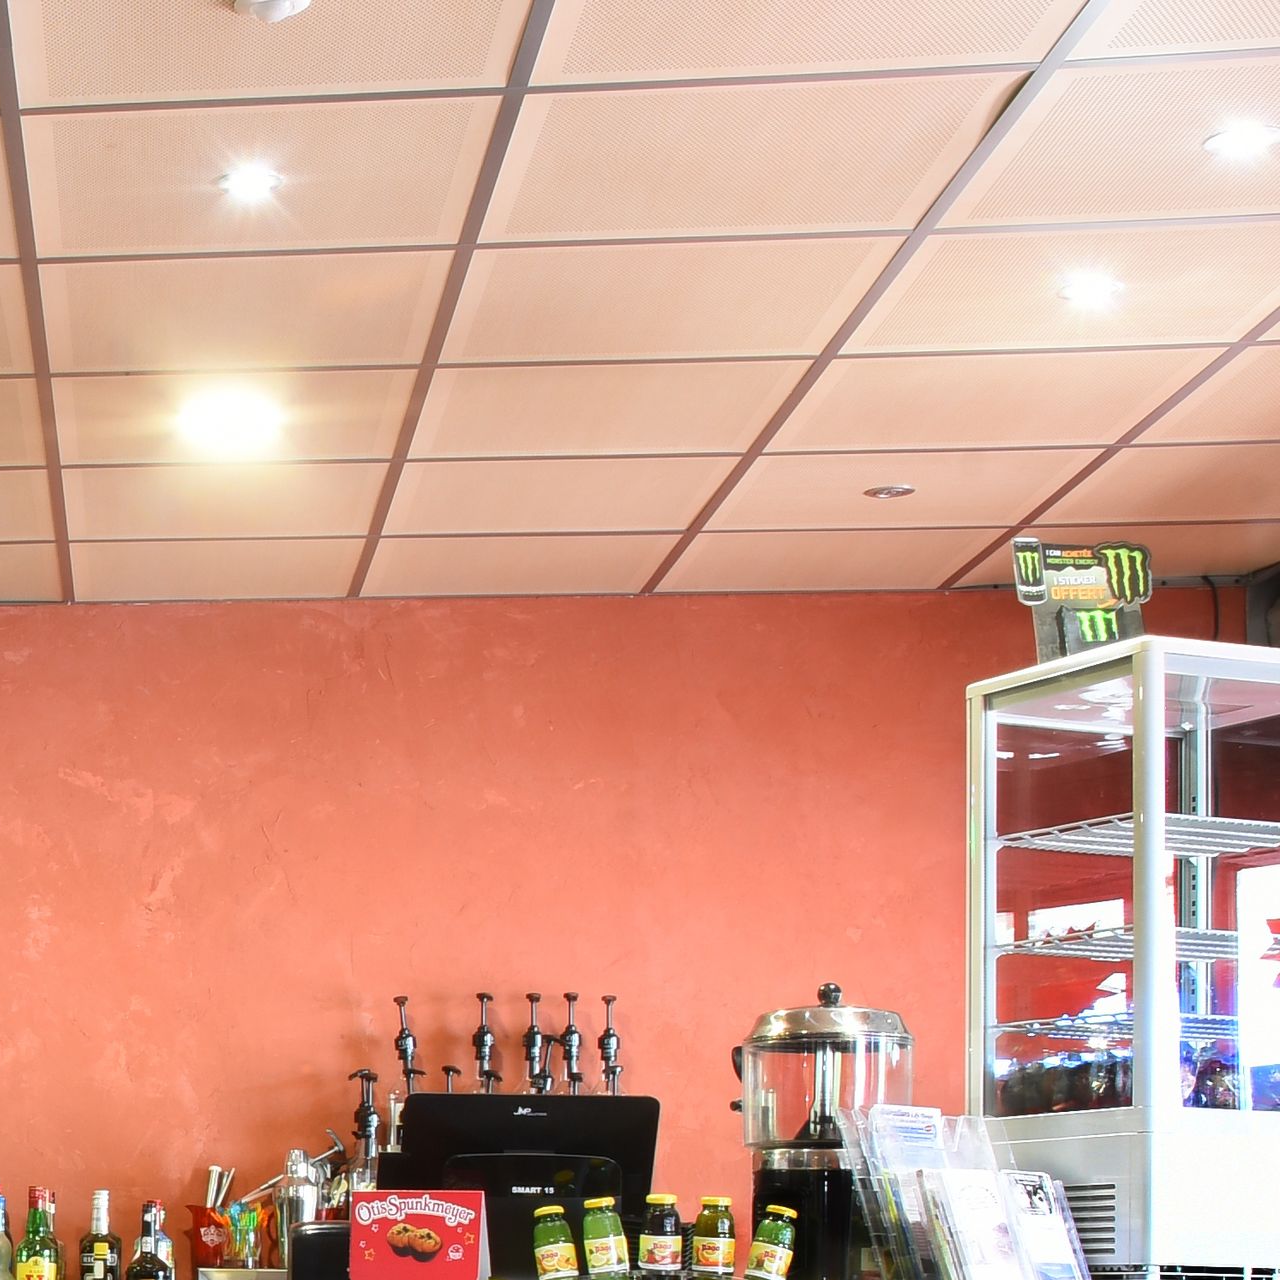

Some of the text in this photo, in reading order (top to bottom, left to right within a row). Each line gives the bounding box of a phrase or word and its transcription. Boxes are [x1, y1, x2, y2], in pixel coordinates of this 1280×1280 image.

[1058, 576, 1096, 585] STICKER
[1051, 586, 1106, 600] OFFERT
[511, 1186, 542, 1194] SMART
[357, 1196, 473, 1224] Otis Spunkmeyer
